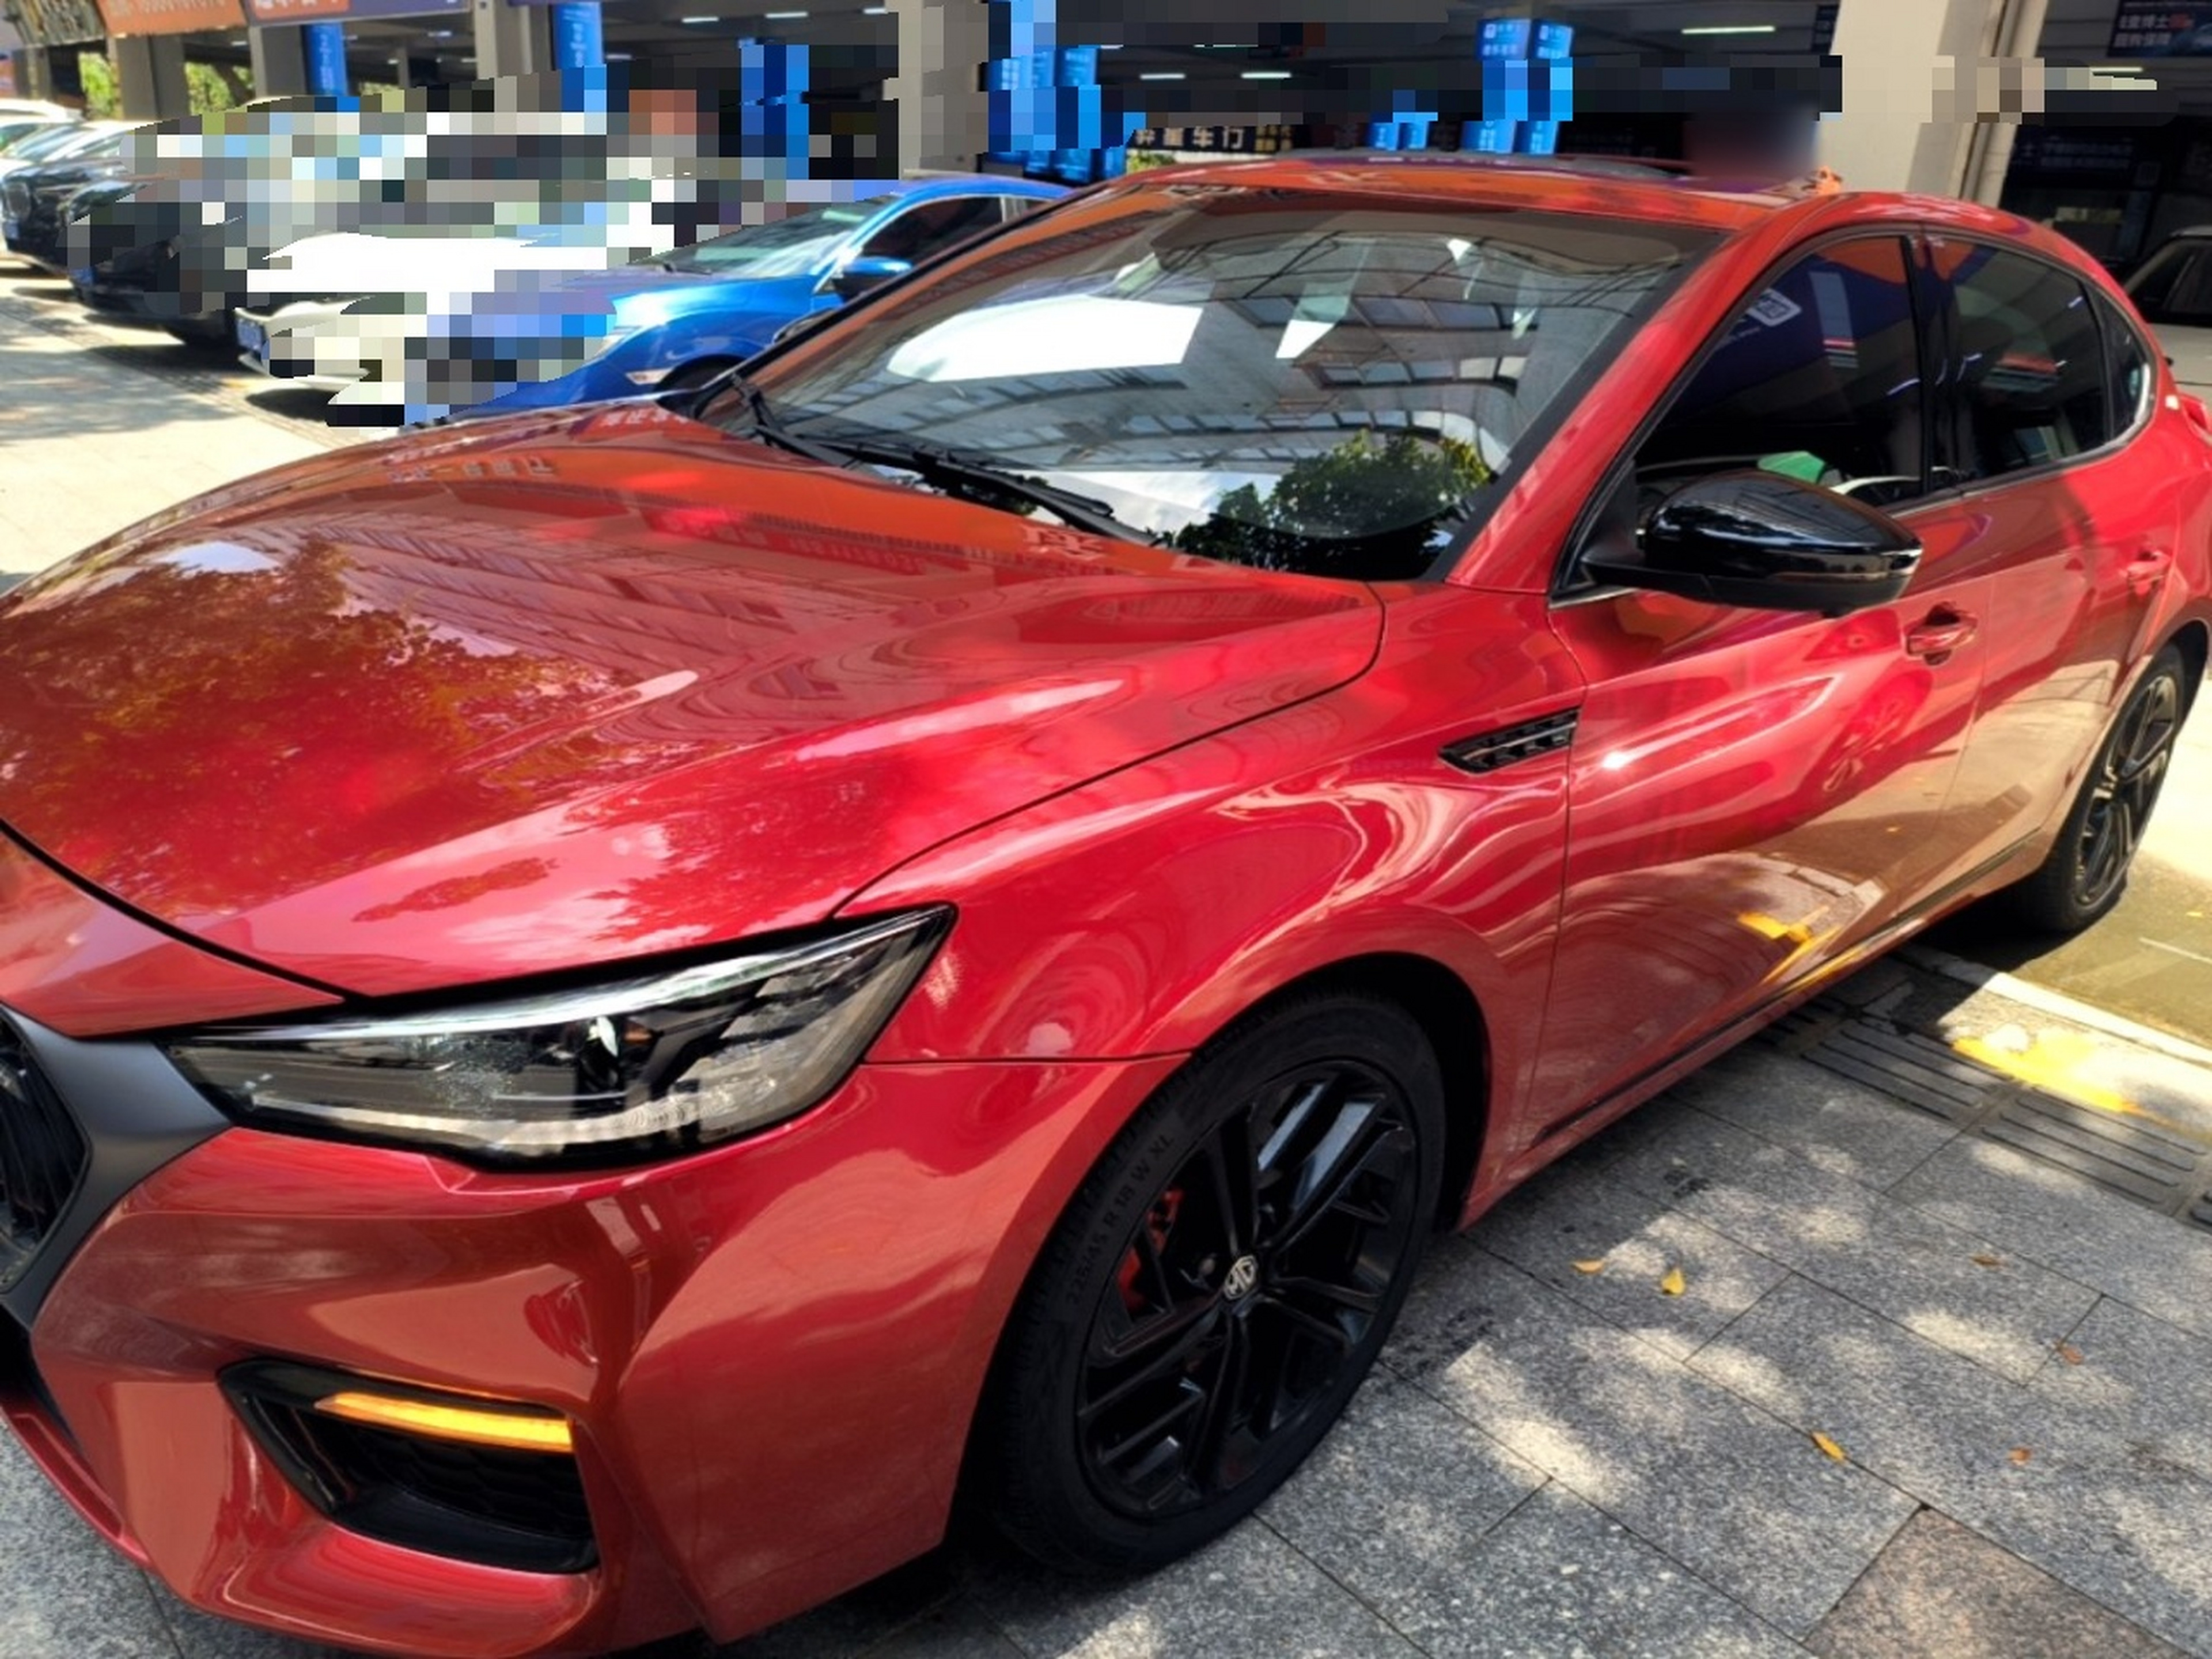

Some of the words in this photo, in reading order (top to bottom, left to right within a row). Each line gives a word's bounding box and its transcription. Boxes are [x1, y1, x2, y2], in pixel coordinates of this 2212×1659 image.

[1103, 1211, 1120, 1229] R
[1117, 1185, 1137, 1209] 18
[1130, 1159, 1150, 1182] W
[1149, 1134, 1176, 1160] XL
[1225, 1260, 1256, 1297] MG
